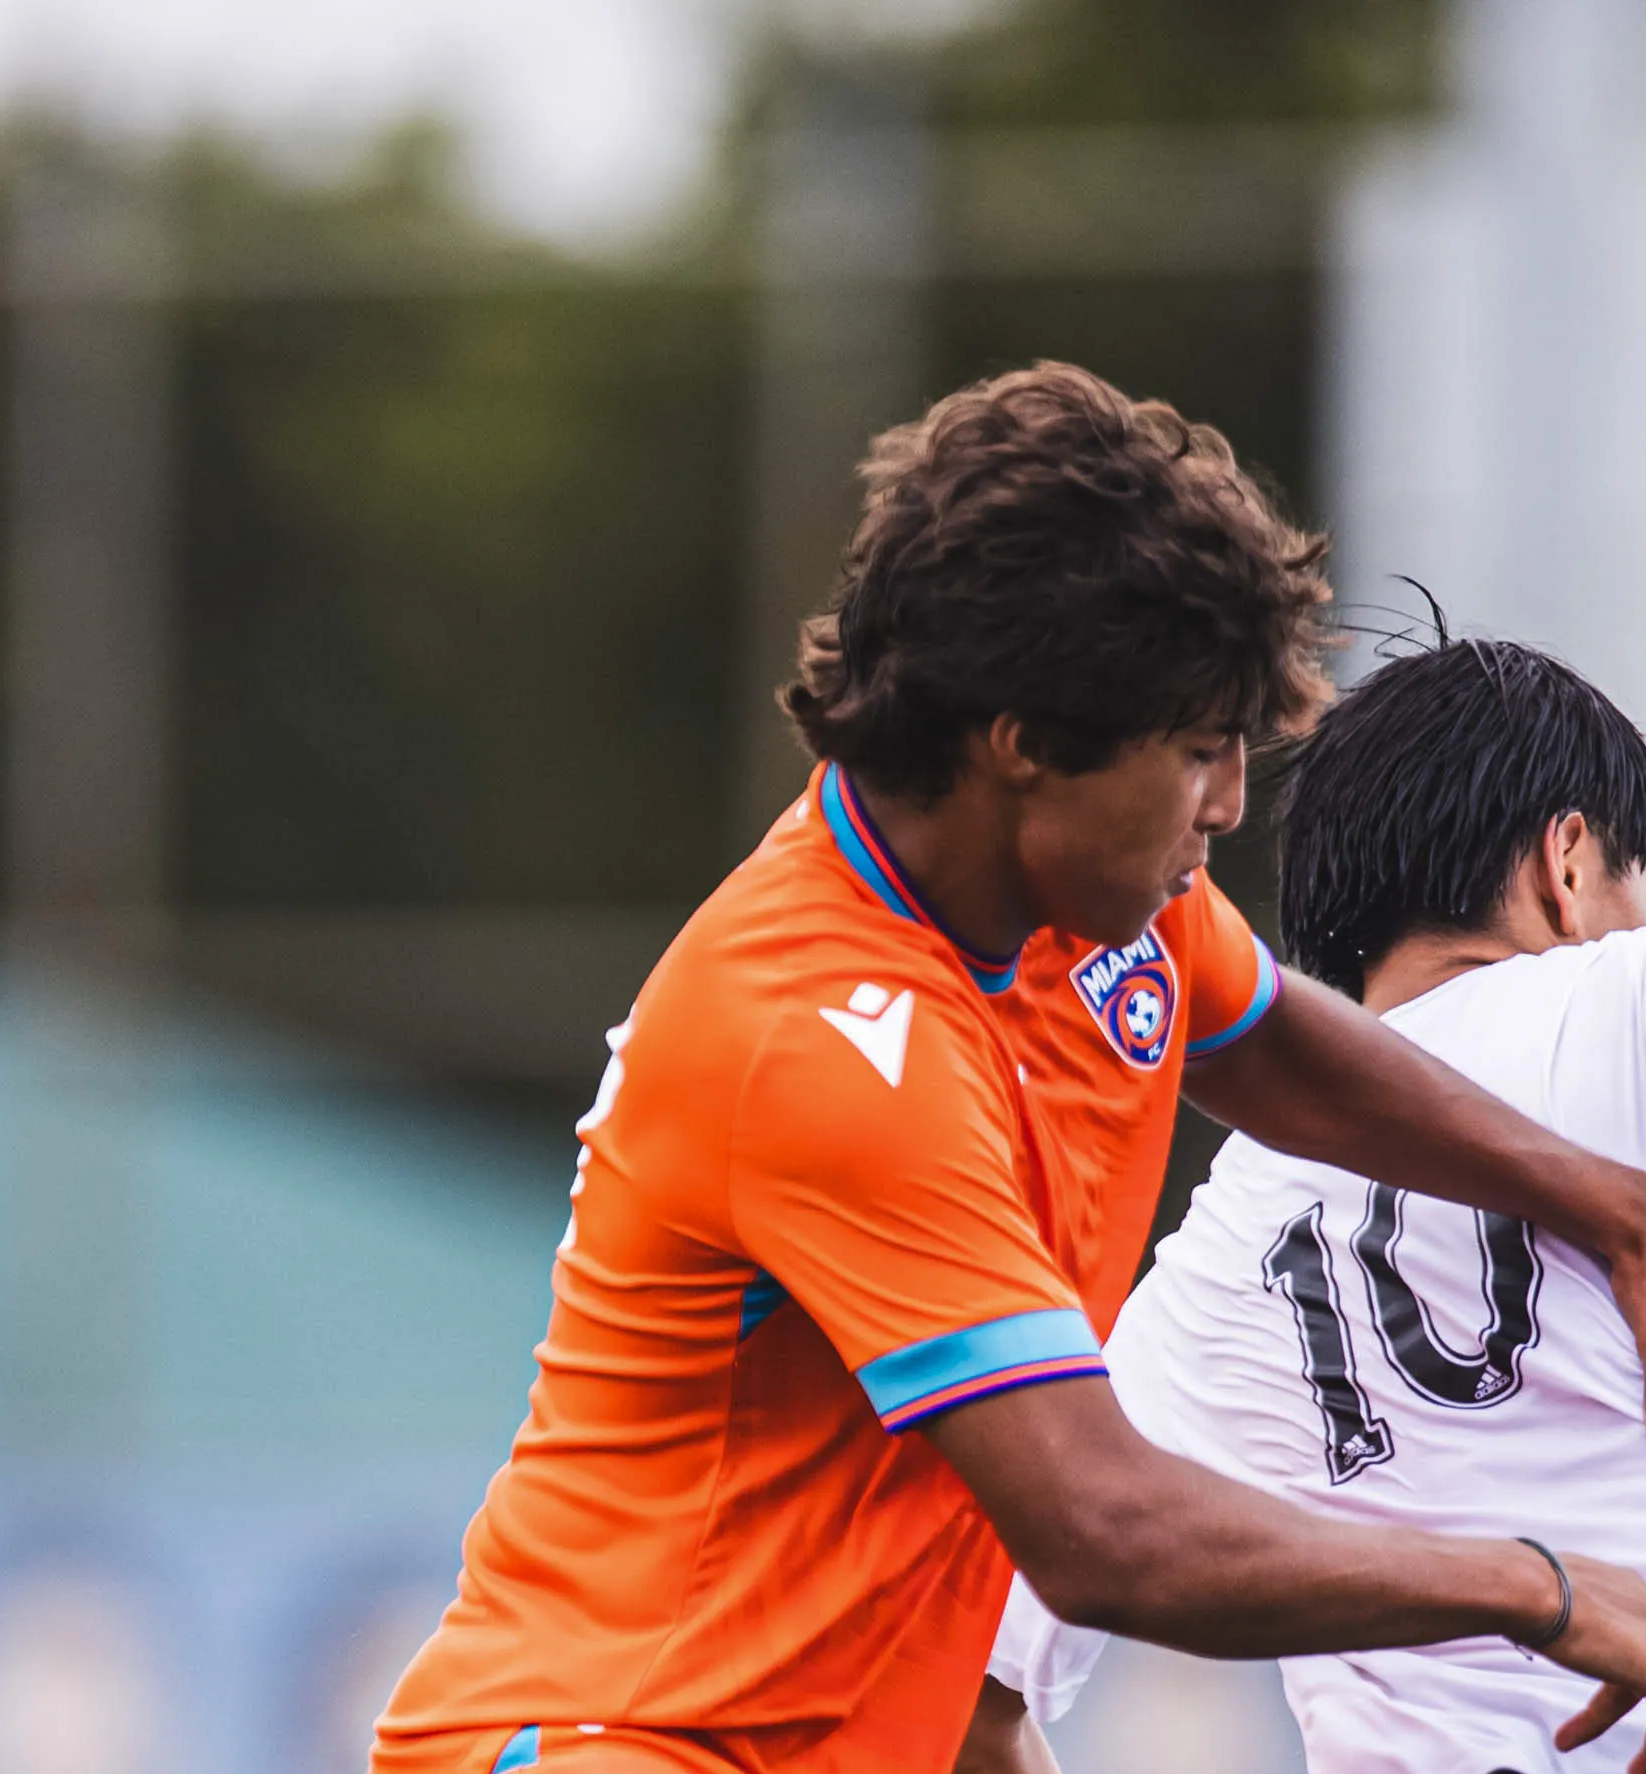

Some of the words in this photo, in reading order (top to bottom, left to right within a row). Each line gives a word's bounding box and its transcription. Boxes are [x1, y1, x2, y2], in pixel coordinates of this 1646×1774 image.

[1080, 932, 1157, 1008] MIAMI
[1148, 1042, 1161, 1061] FC
[1262, 1180, 1544, 1486] 10
[1474, 1374, 1511, 1400] adidas
